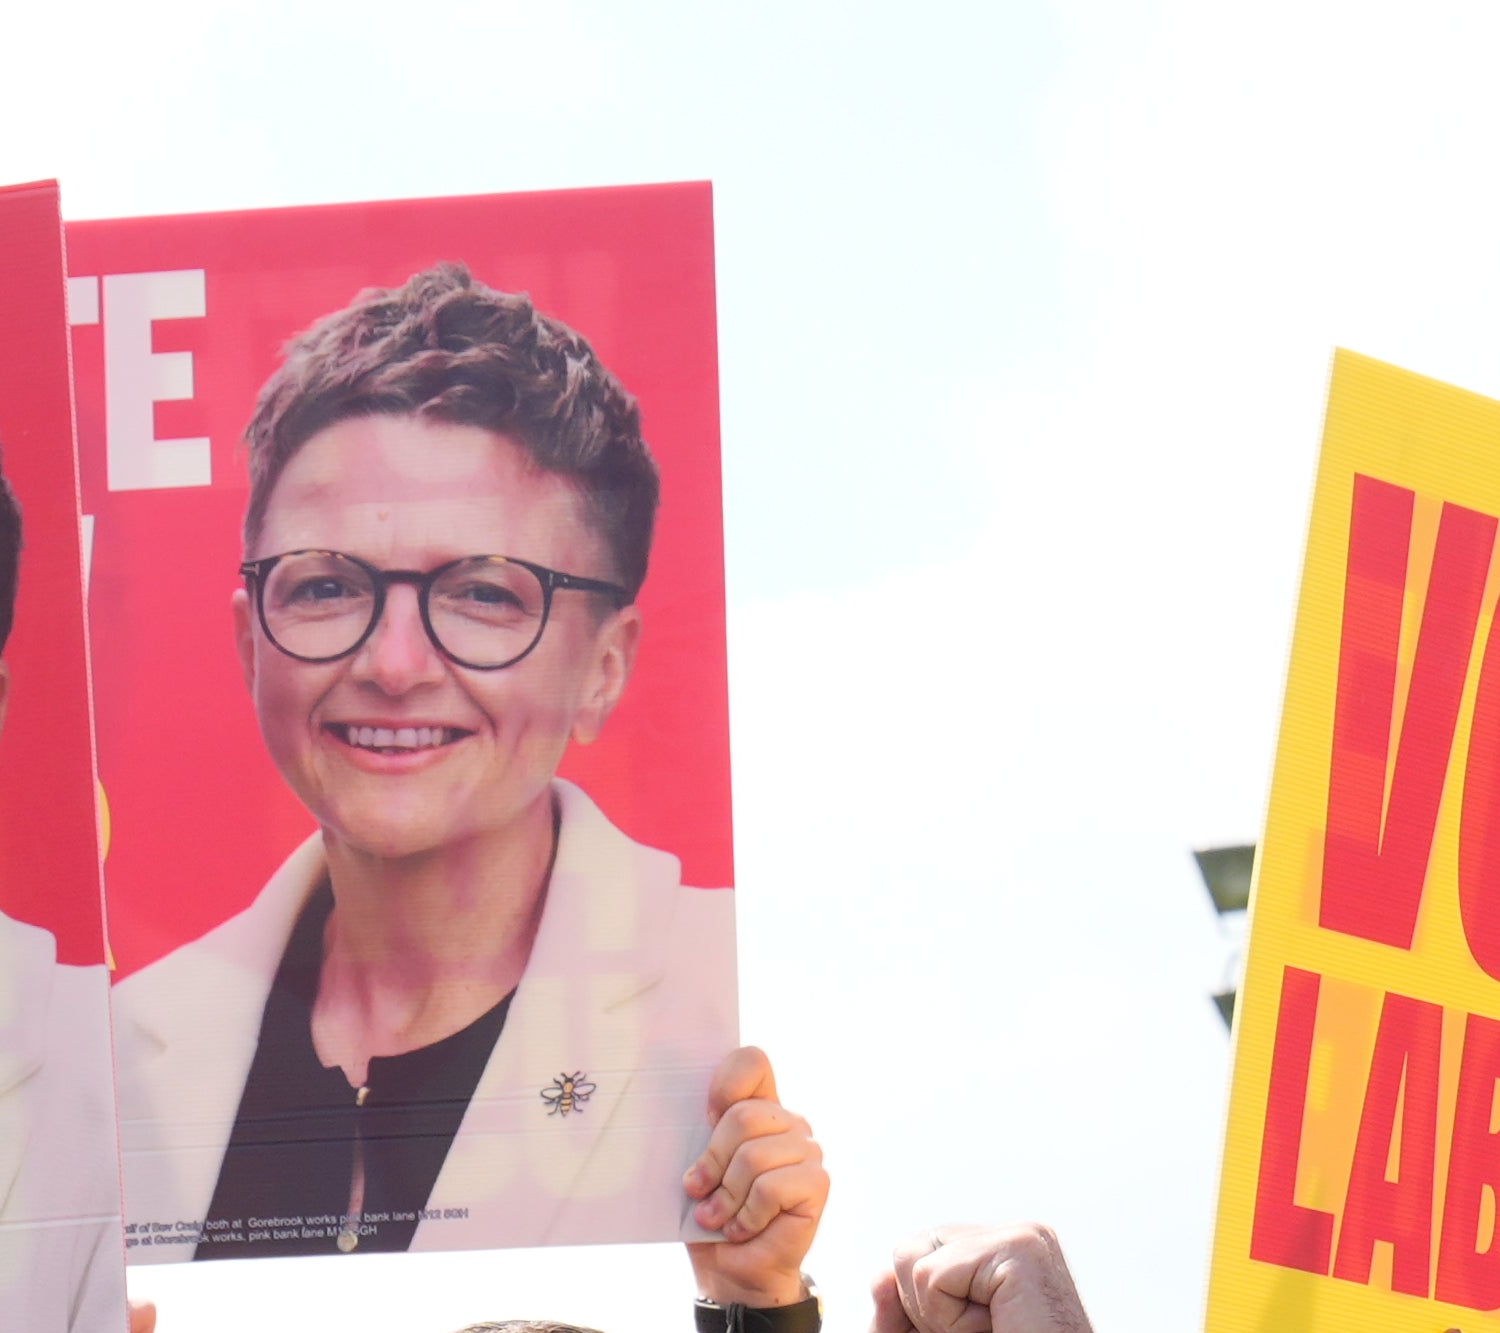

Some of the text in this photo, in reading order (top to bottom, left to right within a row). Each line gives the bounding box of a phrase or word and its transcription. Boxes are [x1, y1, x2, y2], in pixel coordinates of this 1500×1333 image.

[206, 1220, 230, 1230] both
[232, 1219, 242, 1229] at
[248, 1216, 303, 1228] Gorebrook
[305, 1214, 337, 1225] works
[364, 1211, 389, 1222] bank
[392, 1211, 415, 1221] lane
[248, 1230, 270, 1243] pink
[273, 1229, 299, 1240] bank
[301, 1228, 324, 1238] lane
